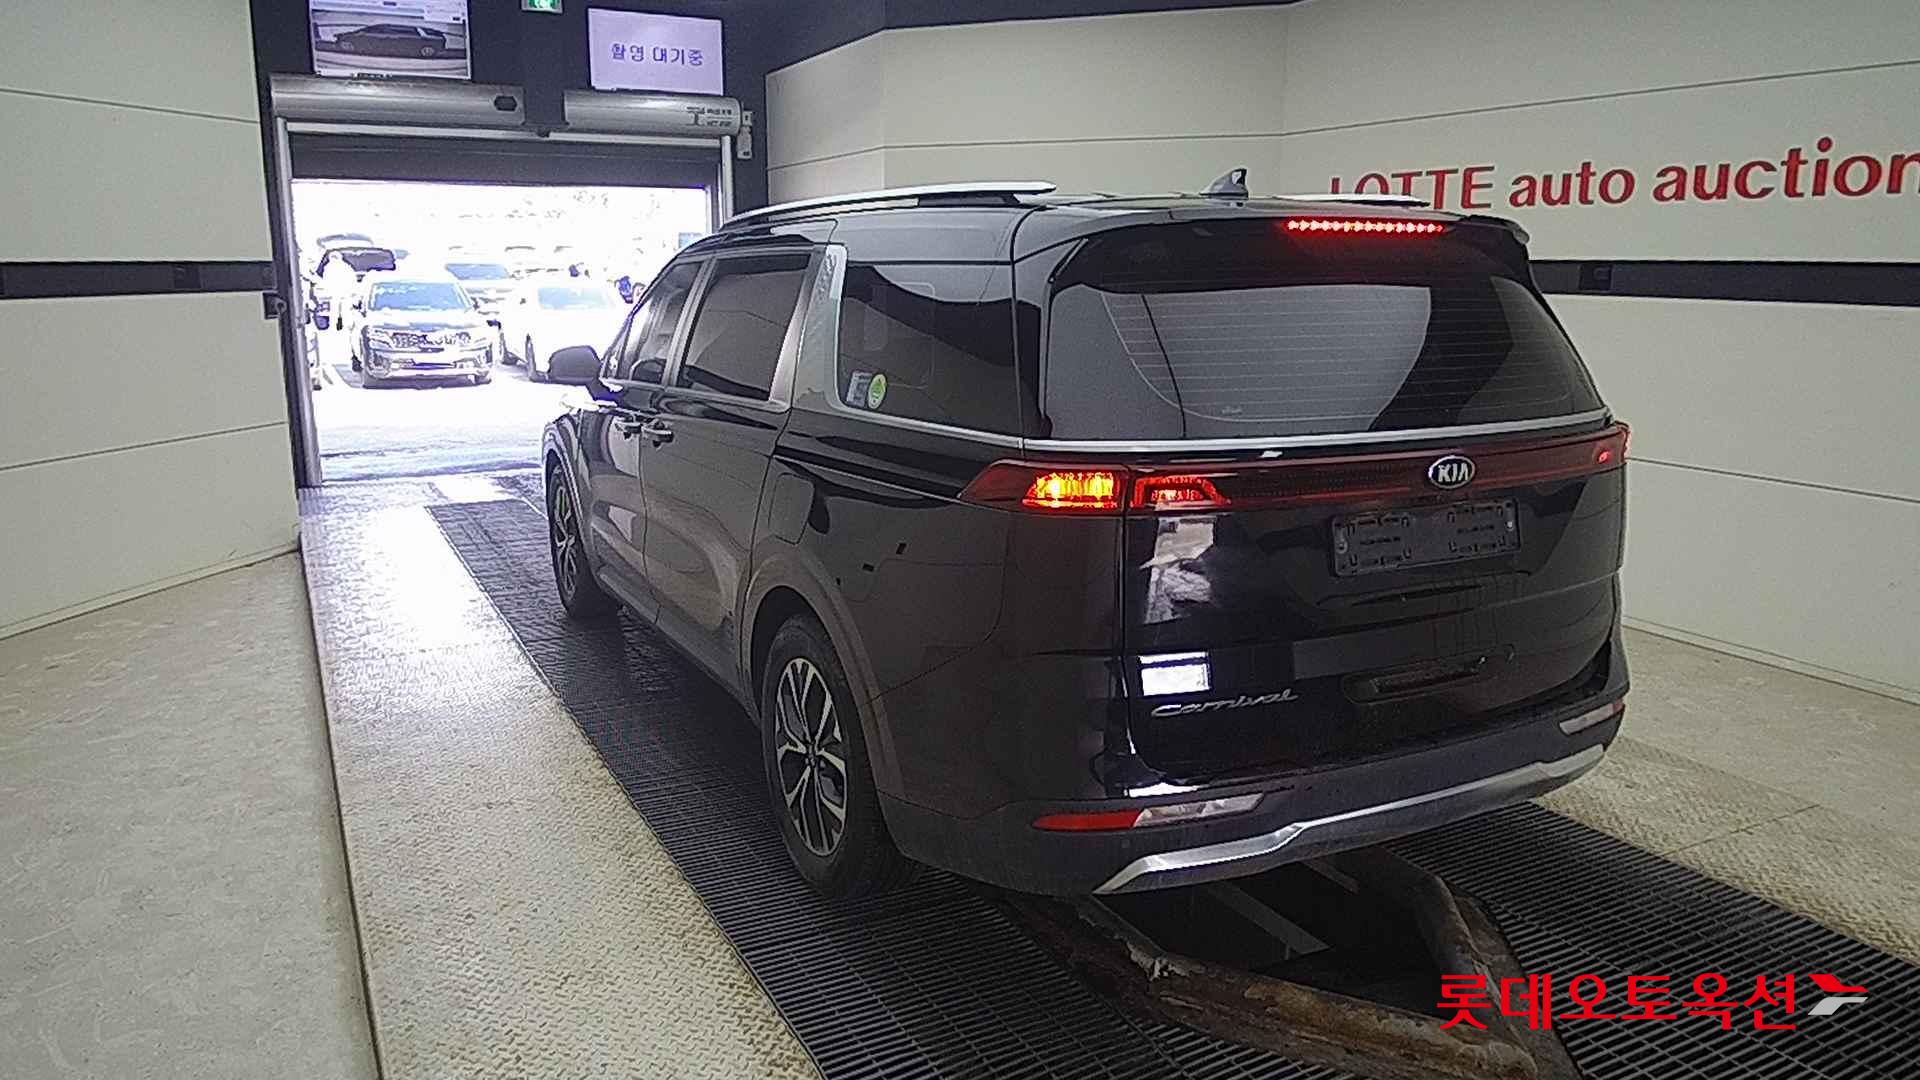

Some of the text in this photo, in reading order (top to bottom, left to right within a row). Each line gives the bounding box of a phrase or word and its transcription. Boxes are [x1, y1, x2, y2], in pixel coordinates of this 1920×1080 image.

[652, 47, 703, 66] 대기중
[1509, 162, 1635, 207] auto
[1653, 136, 1920, 202] auction
[1438, 463, 1469, 482] KIA
[1151, 689, 1298, 717] Carnival
